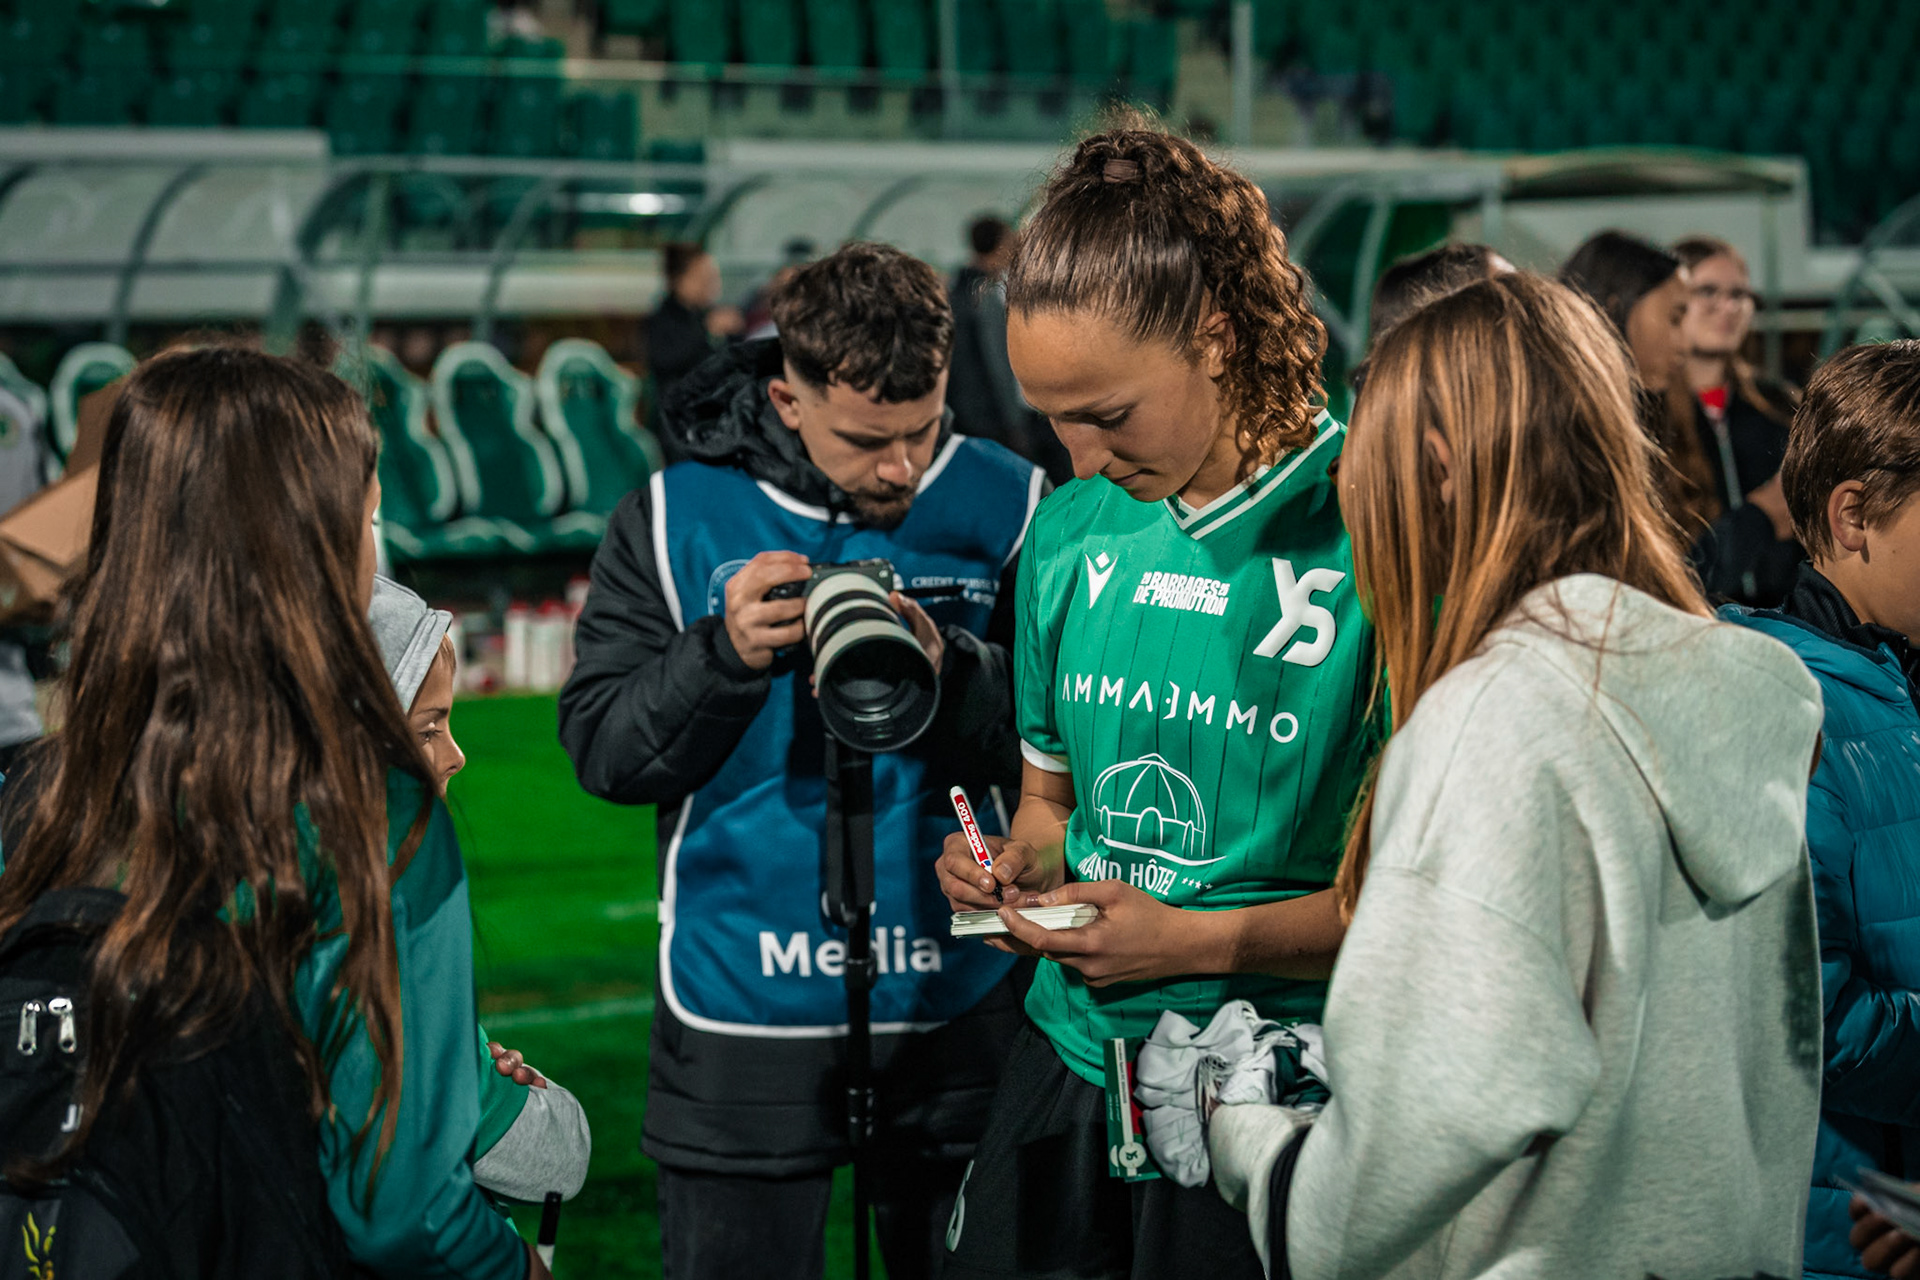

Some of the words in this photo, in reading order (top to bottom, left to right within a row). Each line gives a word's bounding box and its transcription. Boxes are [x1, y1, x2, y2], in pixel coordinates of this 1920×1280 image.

[1149, 571, 1221, 598] BARRAGES
[1132, 585, 1150, 604] DE
[1149, 587, 1230, 617] PROMOTION
[1252, 557, 1346, 668] YS
[957, 801, 971, 823] 400
[1129, 857, 1178, 896] HÔTEL
